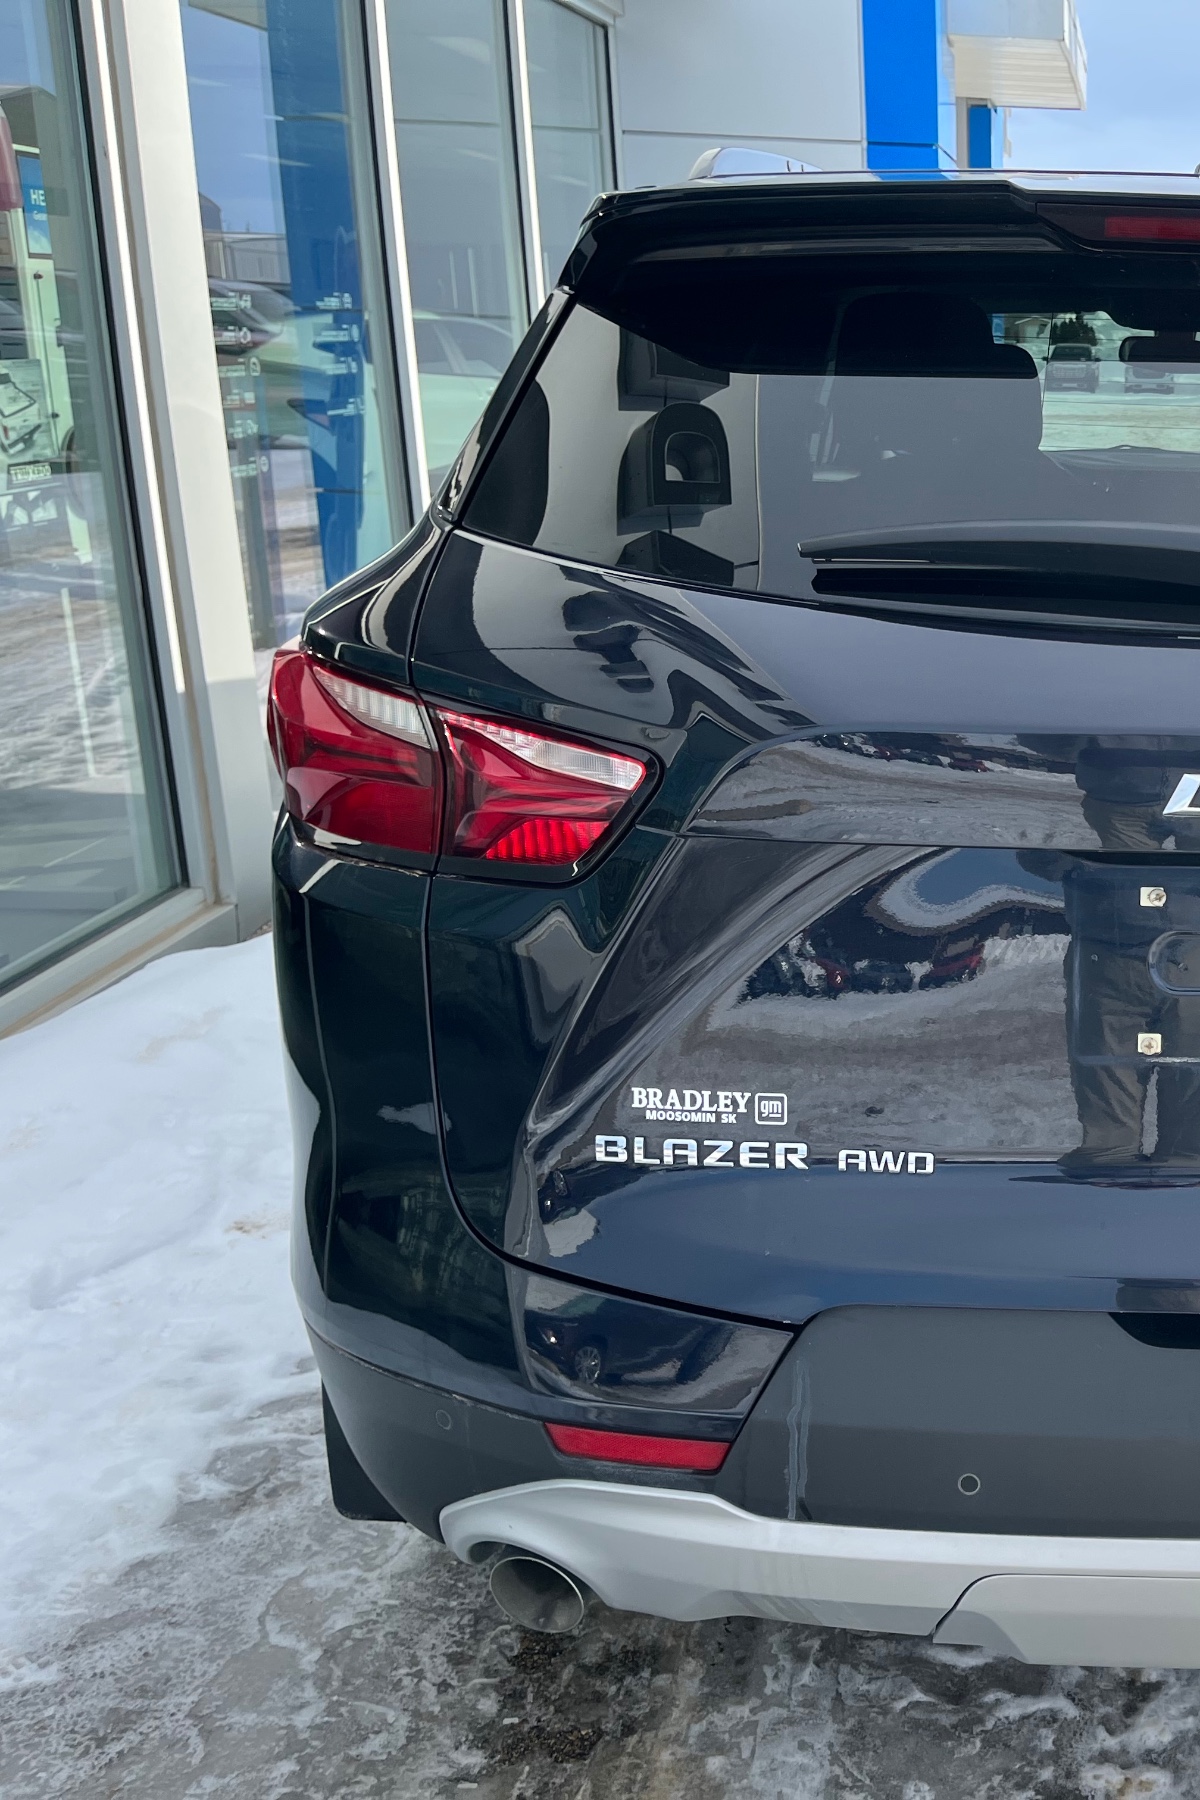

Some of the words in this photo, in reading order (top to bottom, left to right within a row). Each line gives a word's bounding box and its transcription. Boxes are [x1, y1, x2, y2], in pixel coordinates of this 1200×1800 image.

[631, 1087, 751, 1113] BRADLEY
[645, 1110, 716, 1123] MOOSOMIN
[721, 1113, 737, 1124] SK
[595, 1134, 809, 1170] BLAZER
[837, 1149, 935, 1174] AWD
